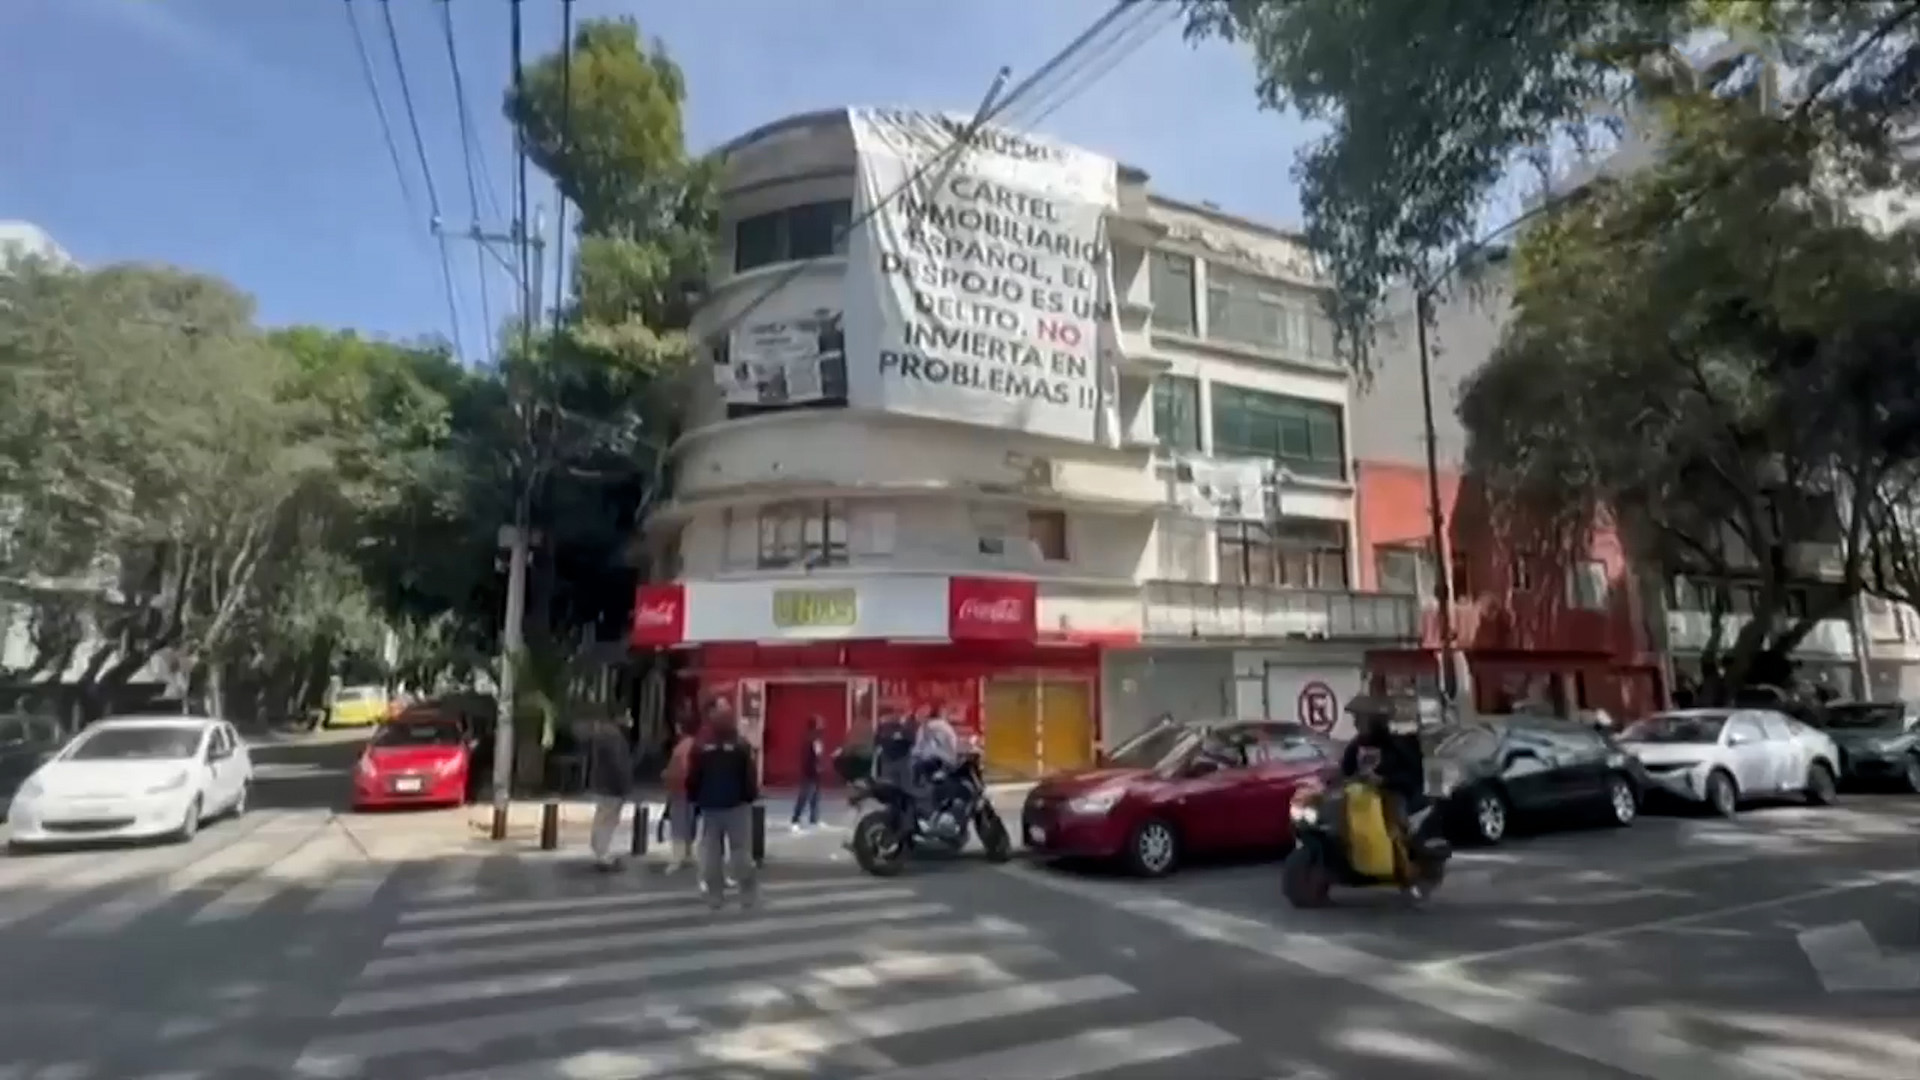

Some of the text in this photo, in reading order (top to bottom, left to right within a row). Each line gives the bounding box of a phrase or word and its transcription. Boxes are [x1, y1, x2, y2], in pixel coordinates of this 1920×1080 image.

[950, 176, 1058, 222] CARTEL
[898, 195, 1103, 264] INMOBILIARIO
[881, 252, 1112, 322] DESPOJO ES UN
[1062, 263, 1089, 290] EL
[904, 320, 1087, 378] INVIERTA EN
[1036, 318, 1082, 347] NO
[879, 350, 1069, 405] PROBLEMAS
